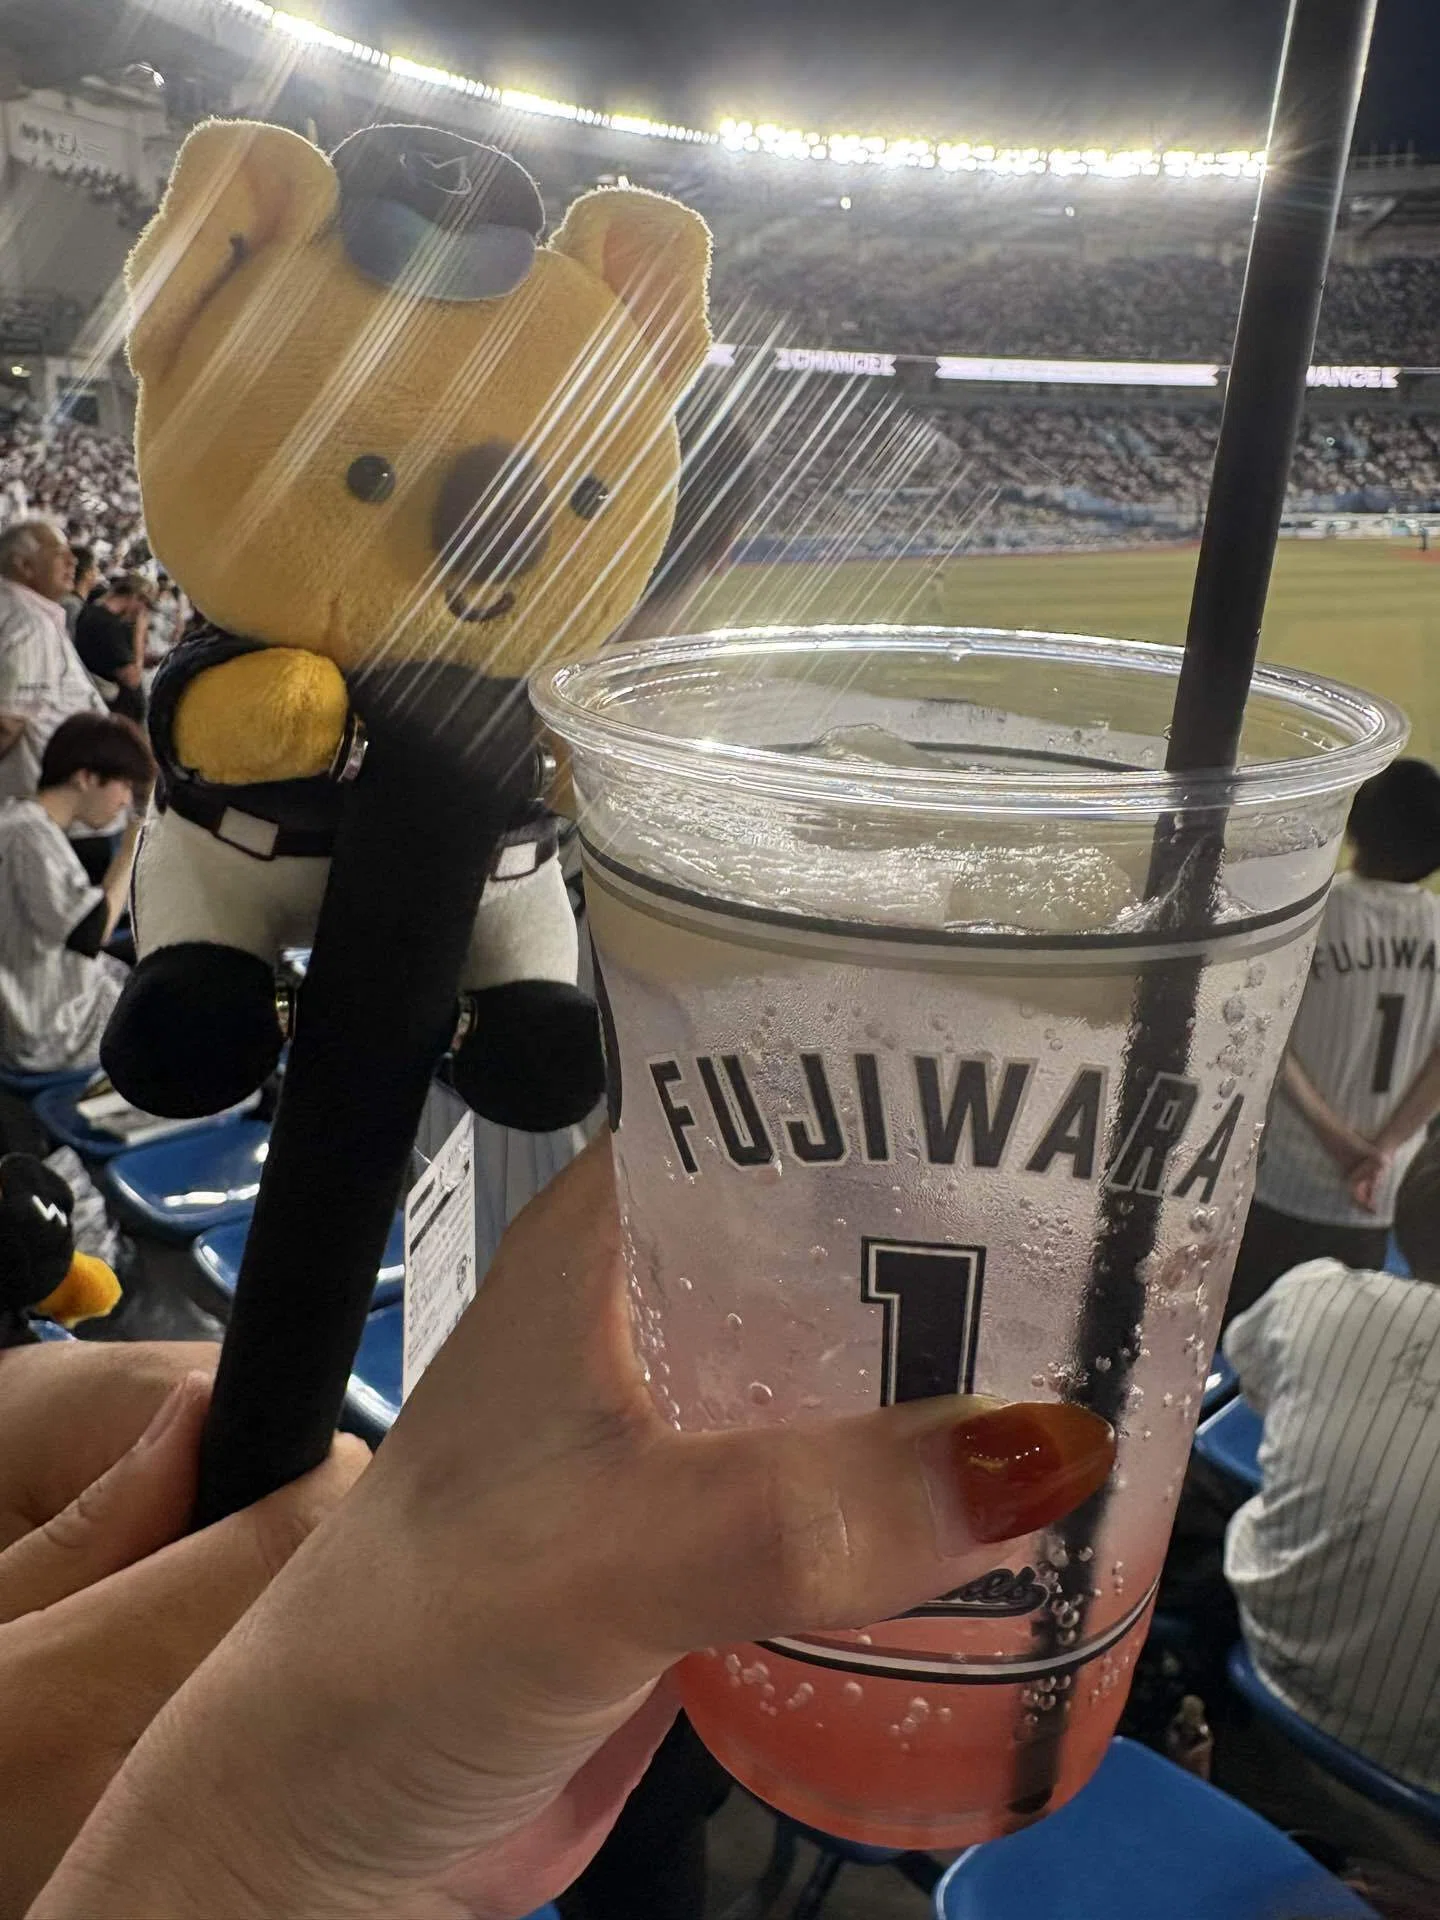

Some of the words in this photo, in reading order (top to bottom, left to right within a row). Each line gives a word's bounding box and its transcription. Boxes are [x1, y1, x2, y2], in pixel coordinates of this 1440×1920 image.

[1311, 936, 1440, 979] FUJIWA
[1371, 991, 1405, 1094] 1
[648, 1052, 1245, 1205] FUJIWARA
[860, 1235, 986, 1408] 1
